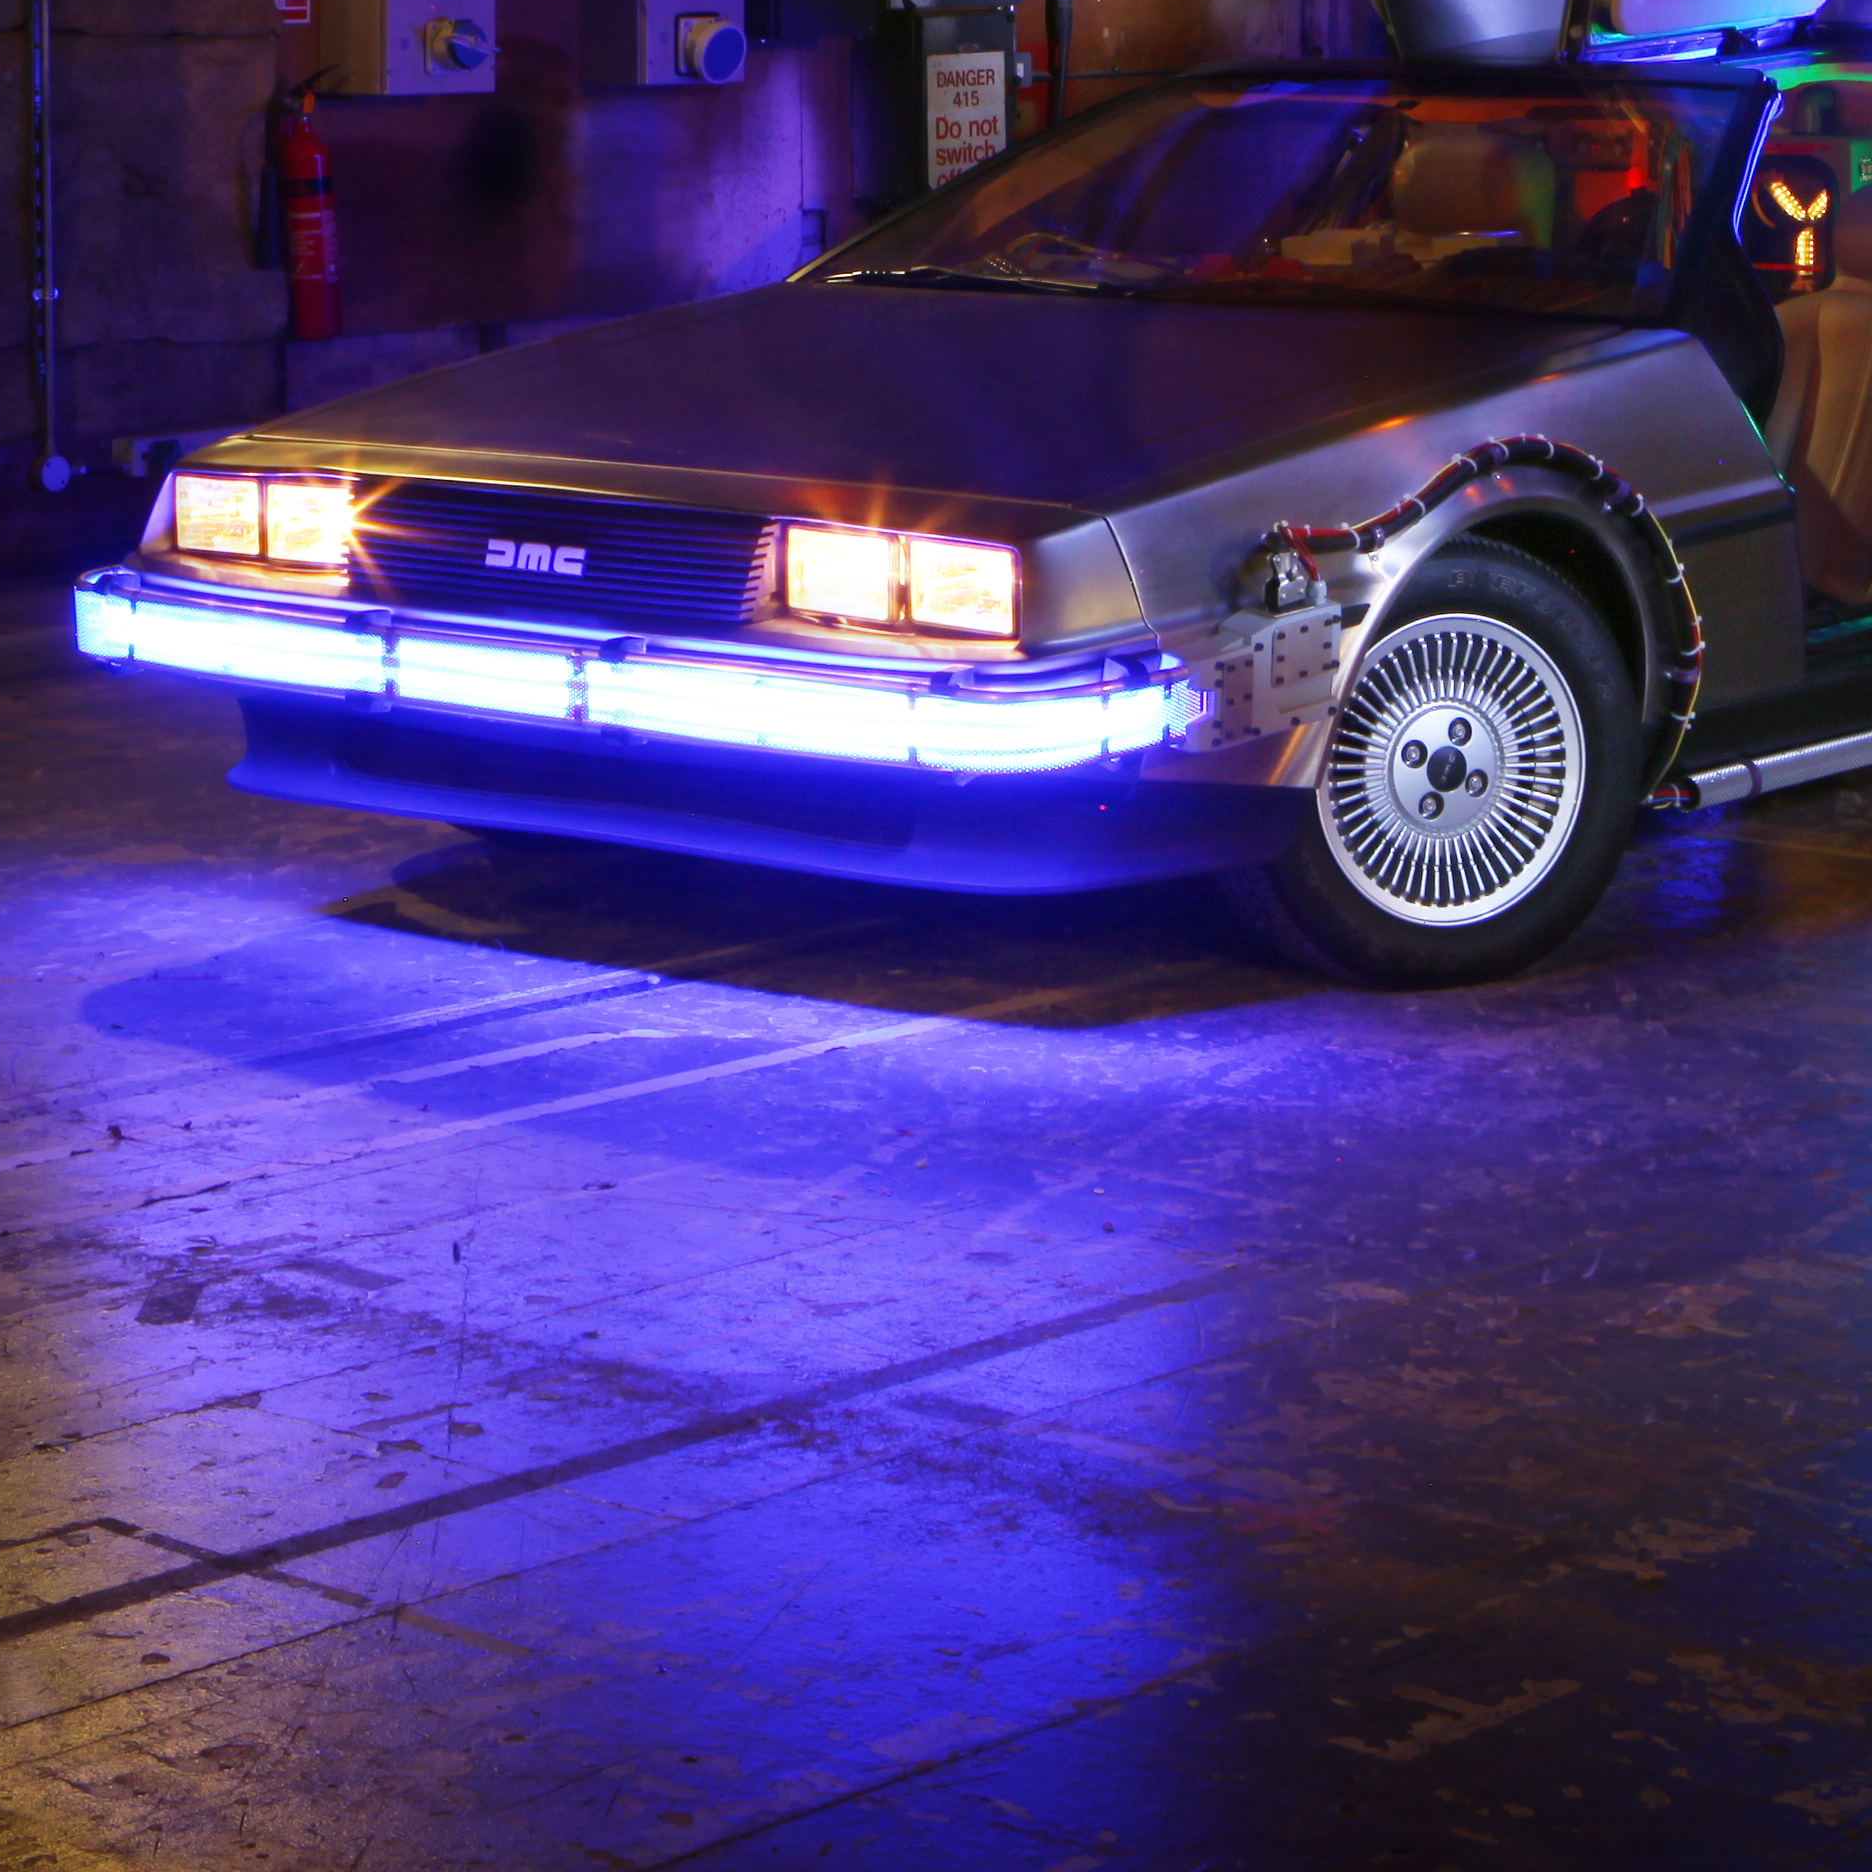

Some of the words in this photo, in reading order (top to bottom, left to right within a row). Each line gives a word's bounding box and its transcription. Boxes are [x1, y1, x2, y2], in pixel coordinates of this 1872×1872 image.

[936, 69, 995, 88] DANGER
[953, 90, 979, 107] 415
[935, 117, 962, 140] Do
[969, 115, 998, 137] not
[935, 140, 996, 166] switch
[484, 538, 587, 576] DMC
